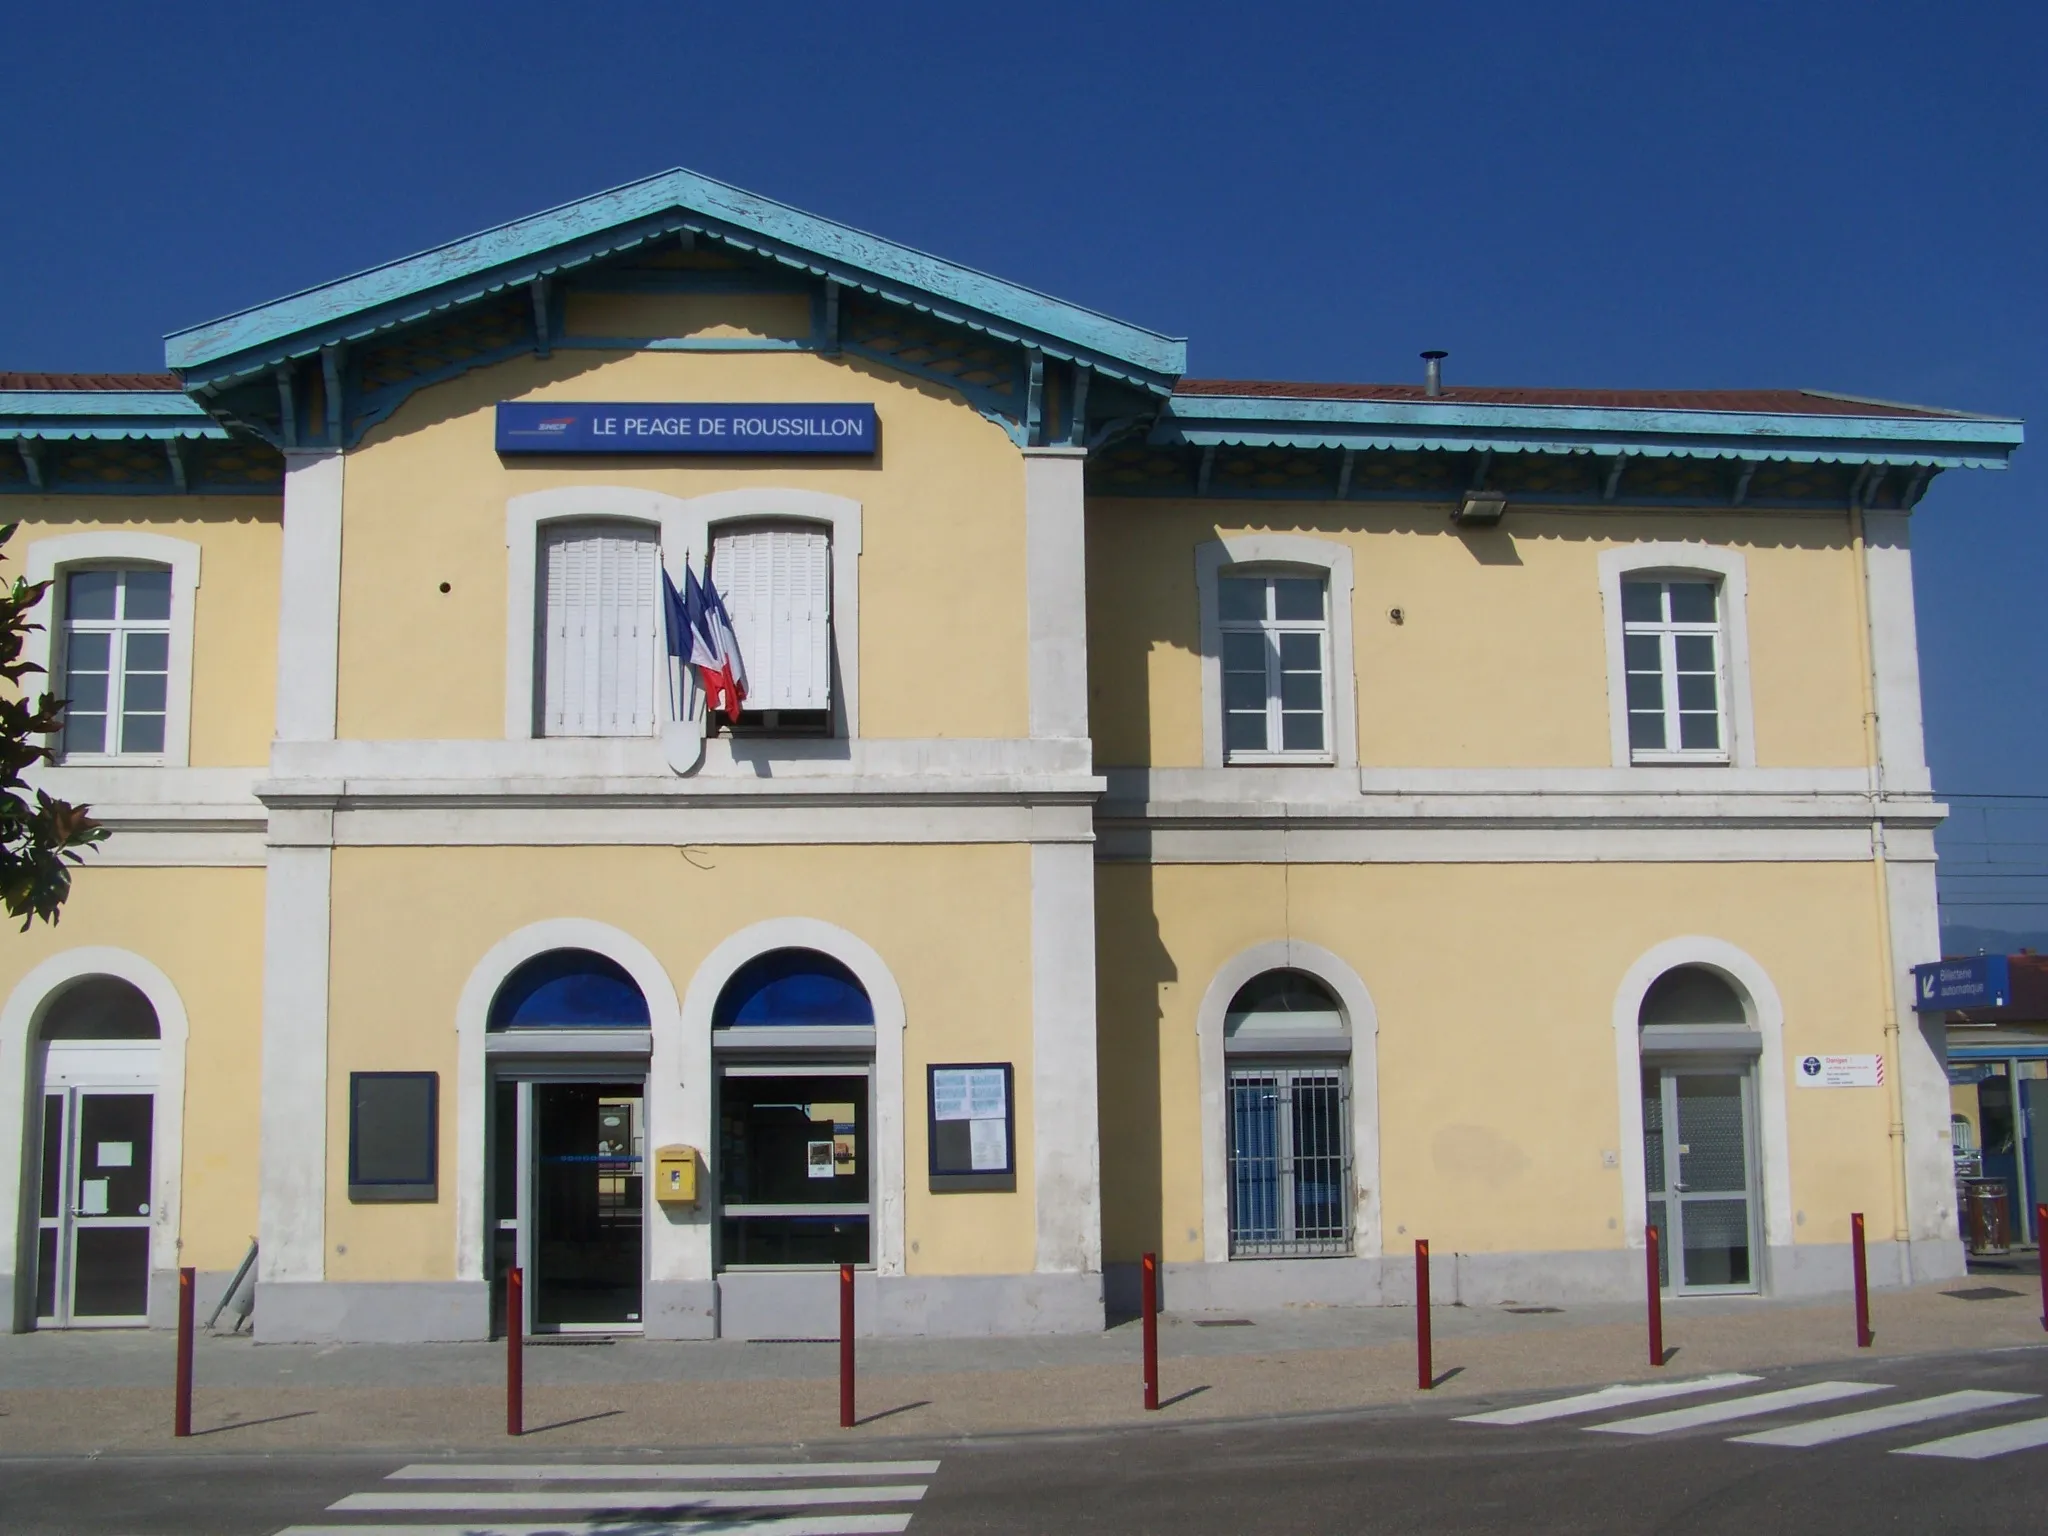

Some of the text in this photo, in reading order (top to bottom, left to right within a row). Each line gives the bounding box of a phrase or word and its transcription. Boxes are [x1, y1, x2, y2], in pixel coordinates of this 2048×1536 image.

[593, 418, 863, 436] LE PEAGE DE ROUSSILLON
